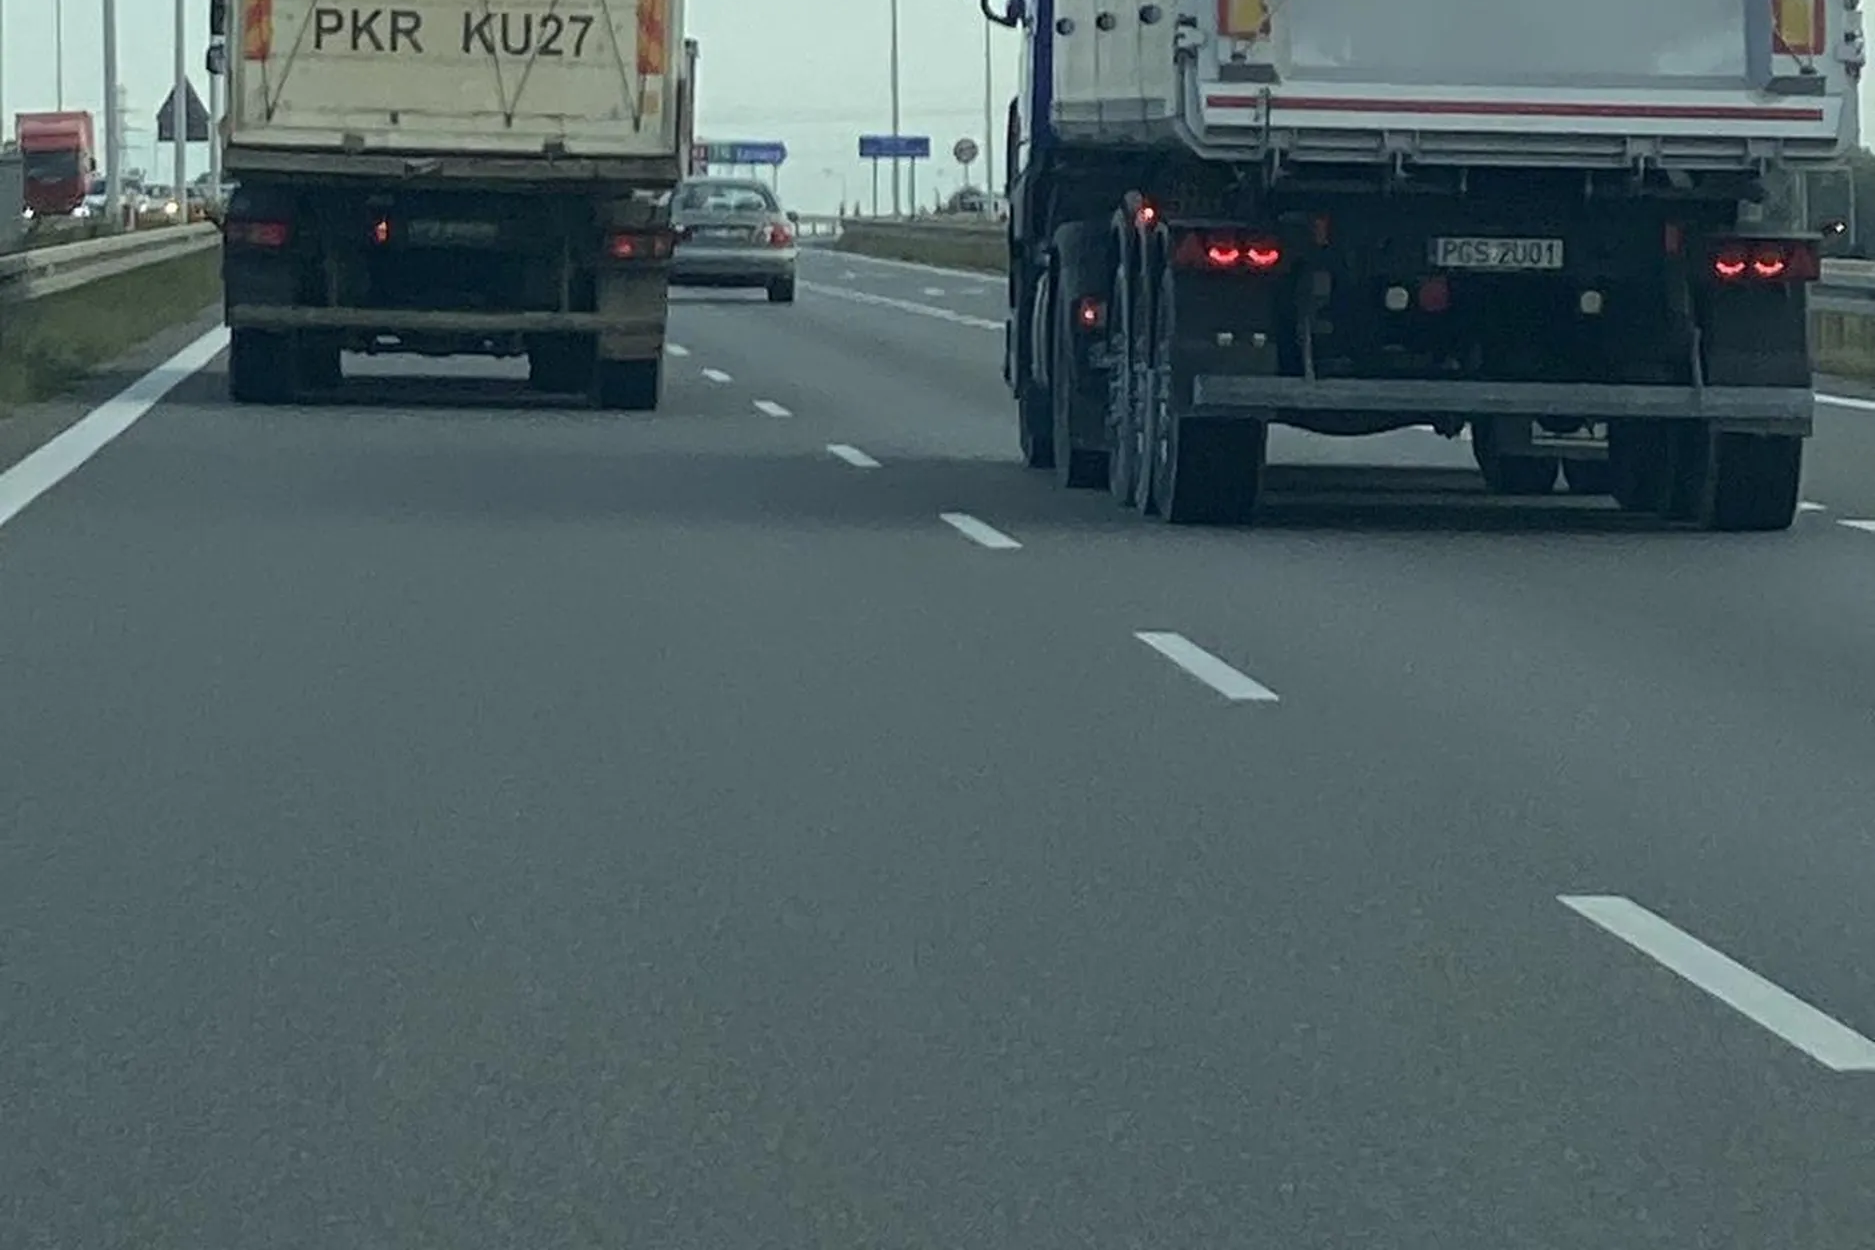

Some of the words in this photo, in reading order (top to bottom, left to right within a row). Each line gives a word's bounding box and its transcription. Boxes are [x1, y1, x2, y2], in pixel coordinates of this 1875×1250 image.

[314, 8, 424, 53] PKR
[461, 11, 595, 57] KU27
[1442, 240, 1489, 263] PGS
[1499, 241, 1554, 265] 2U01
